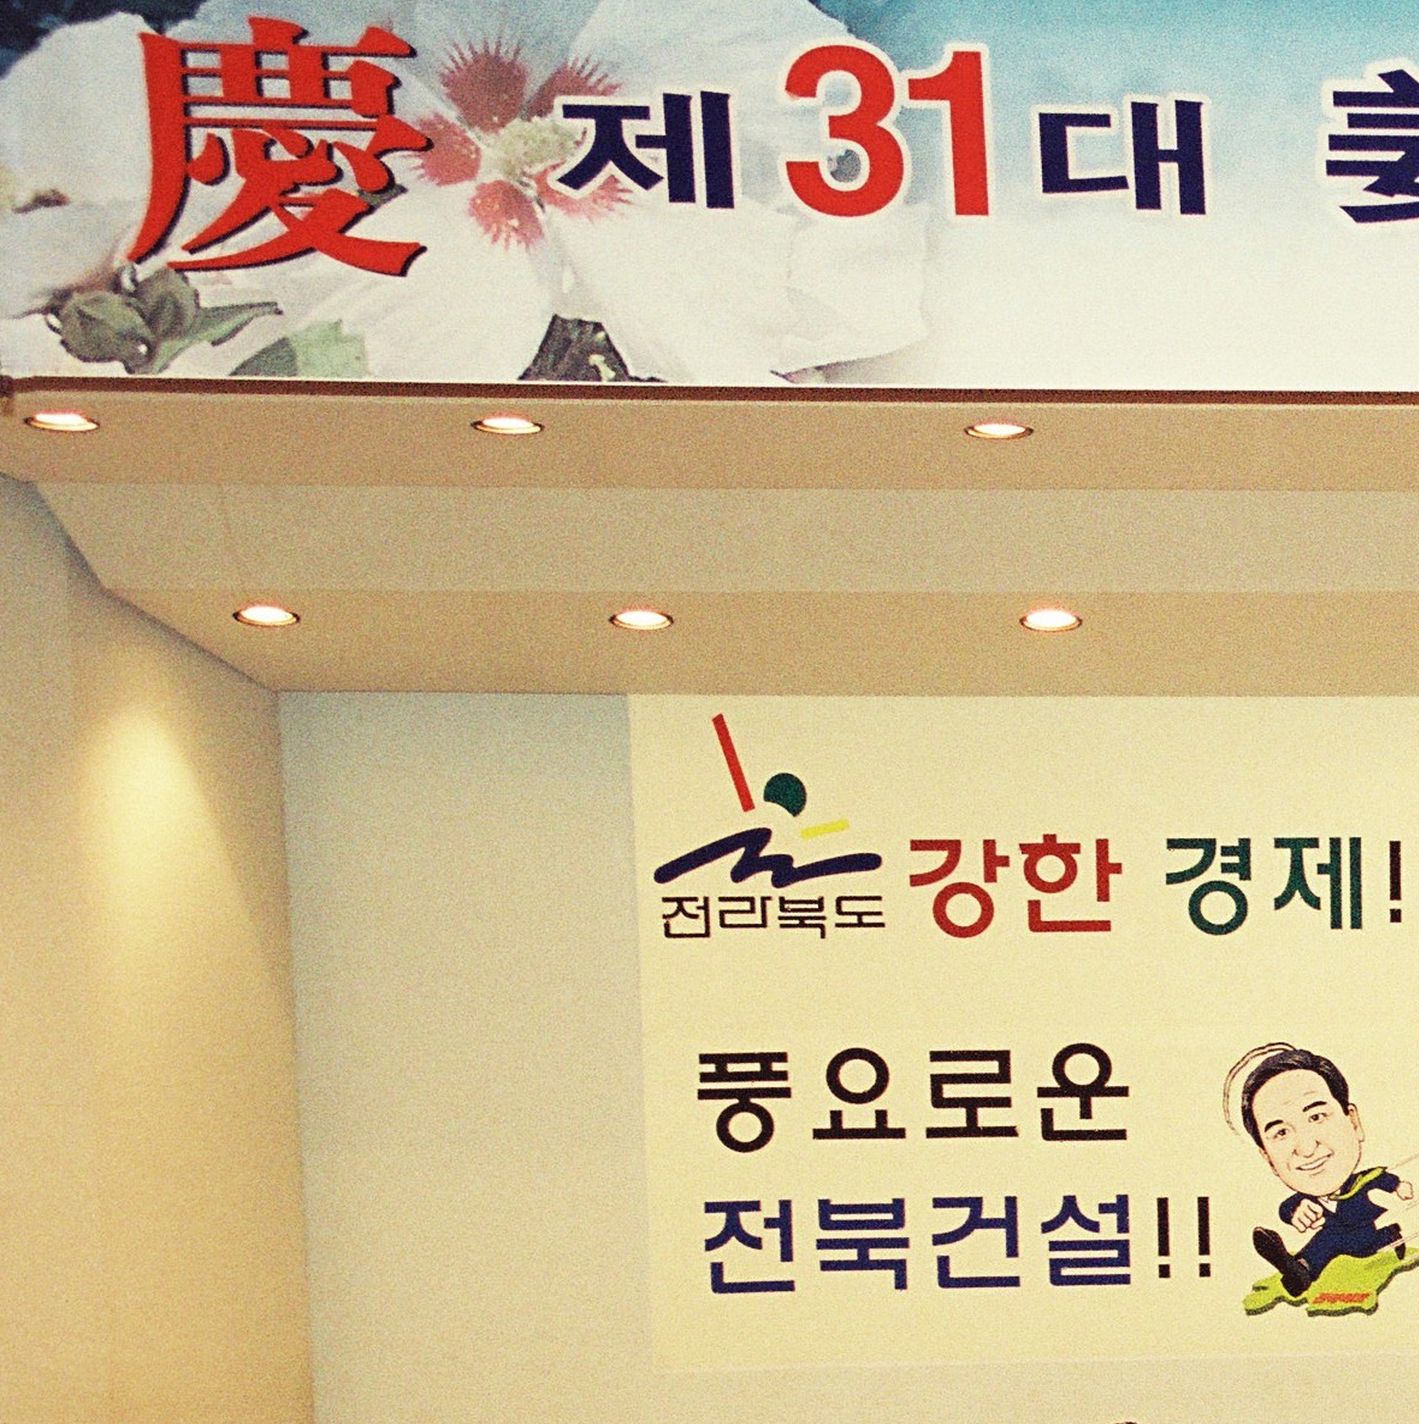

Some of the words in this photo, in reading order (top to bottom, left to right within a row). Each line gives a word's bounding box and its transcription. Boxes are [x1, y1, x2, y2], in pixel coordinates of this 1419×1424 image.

[130, 18, 427, 275] 慶
[660, 894, 886, 940] 전라북도
[909, 833, 1123, 939] 강한
[697, 1042, 1129, 1153] 풍요로운
[704, 1194, 1212, 1294] 전북건설!!
